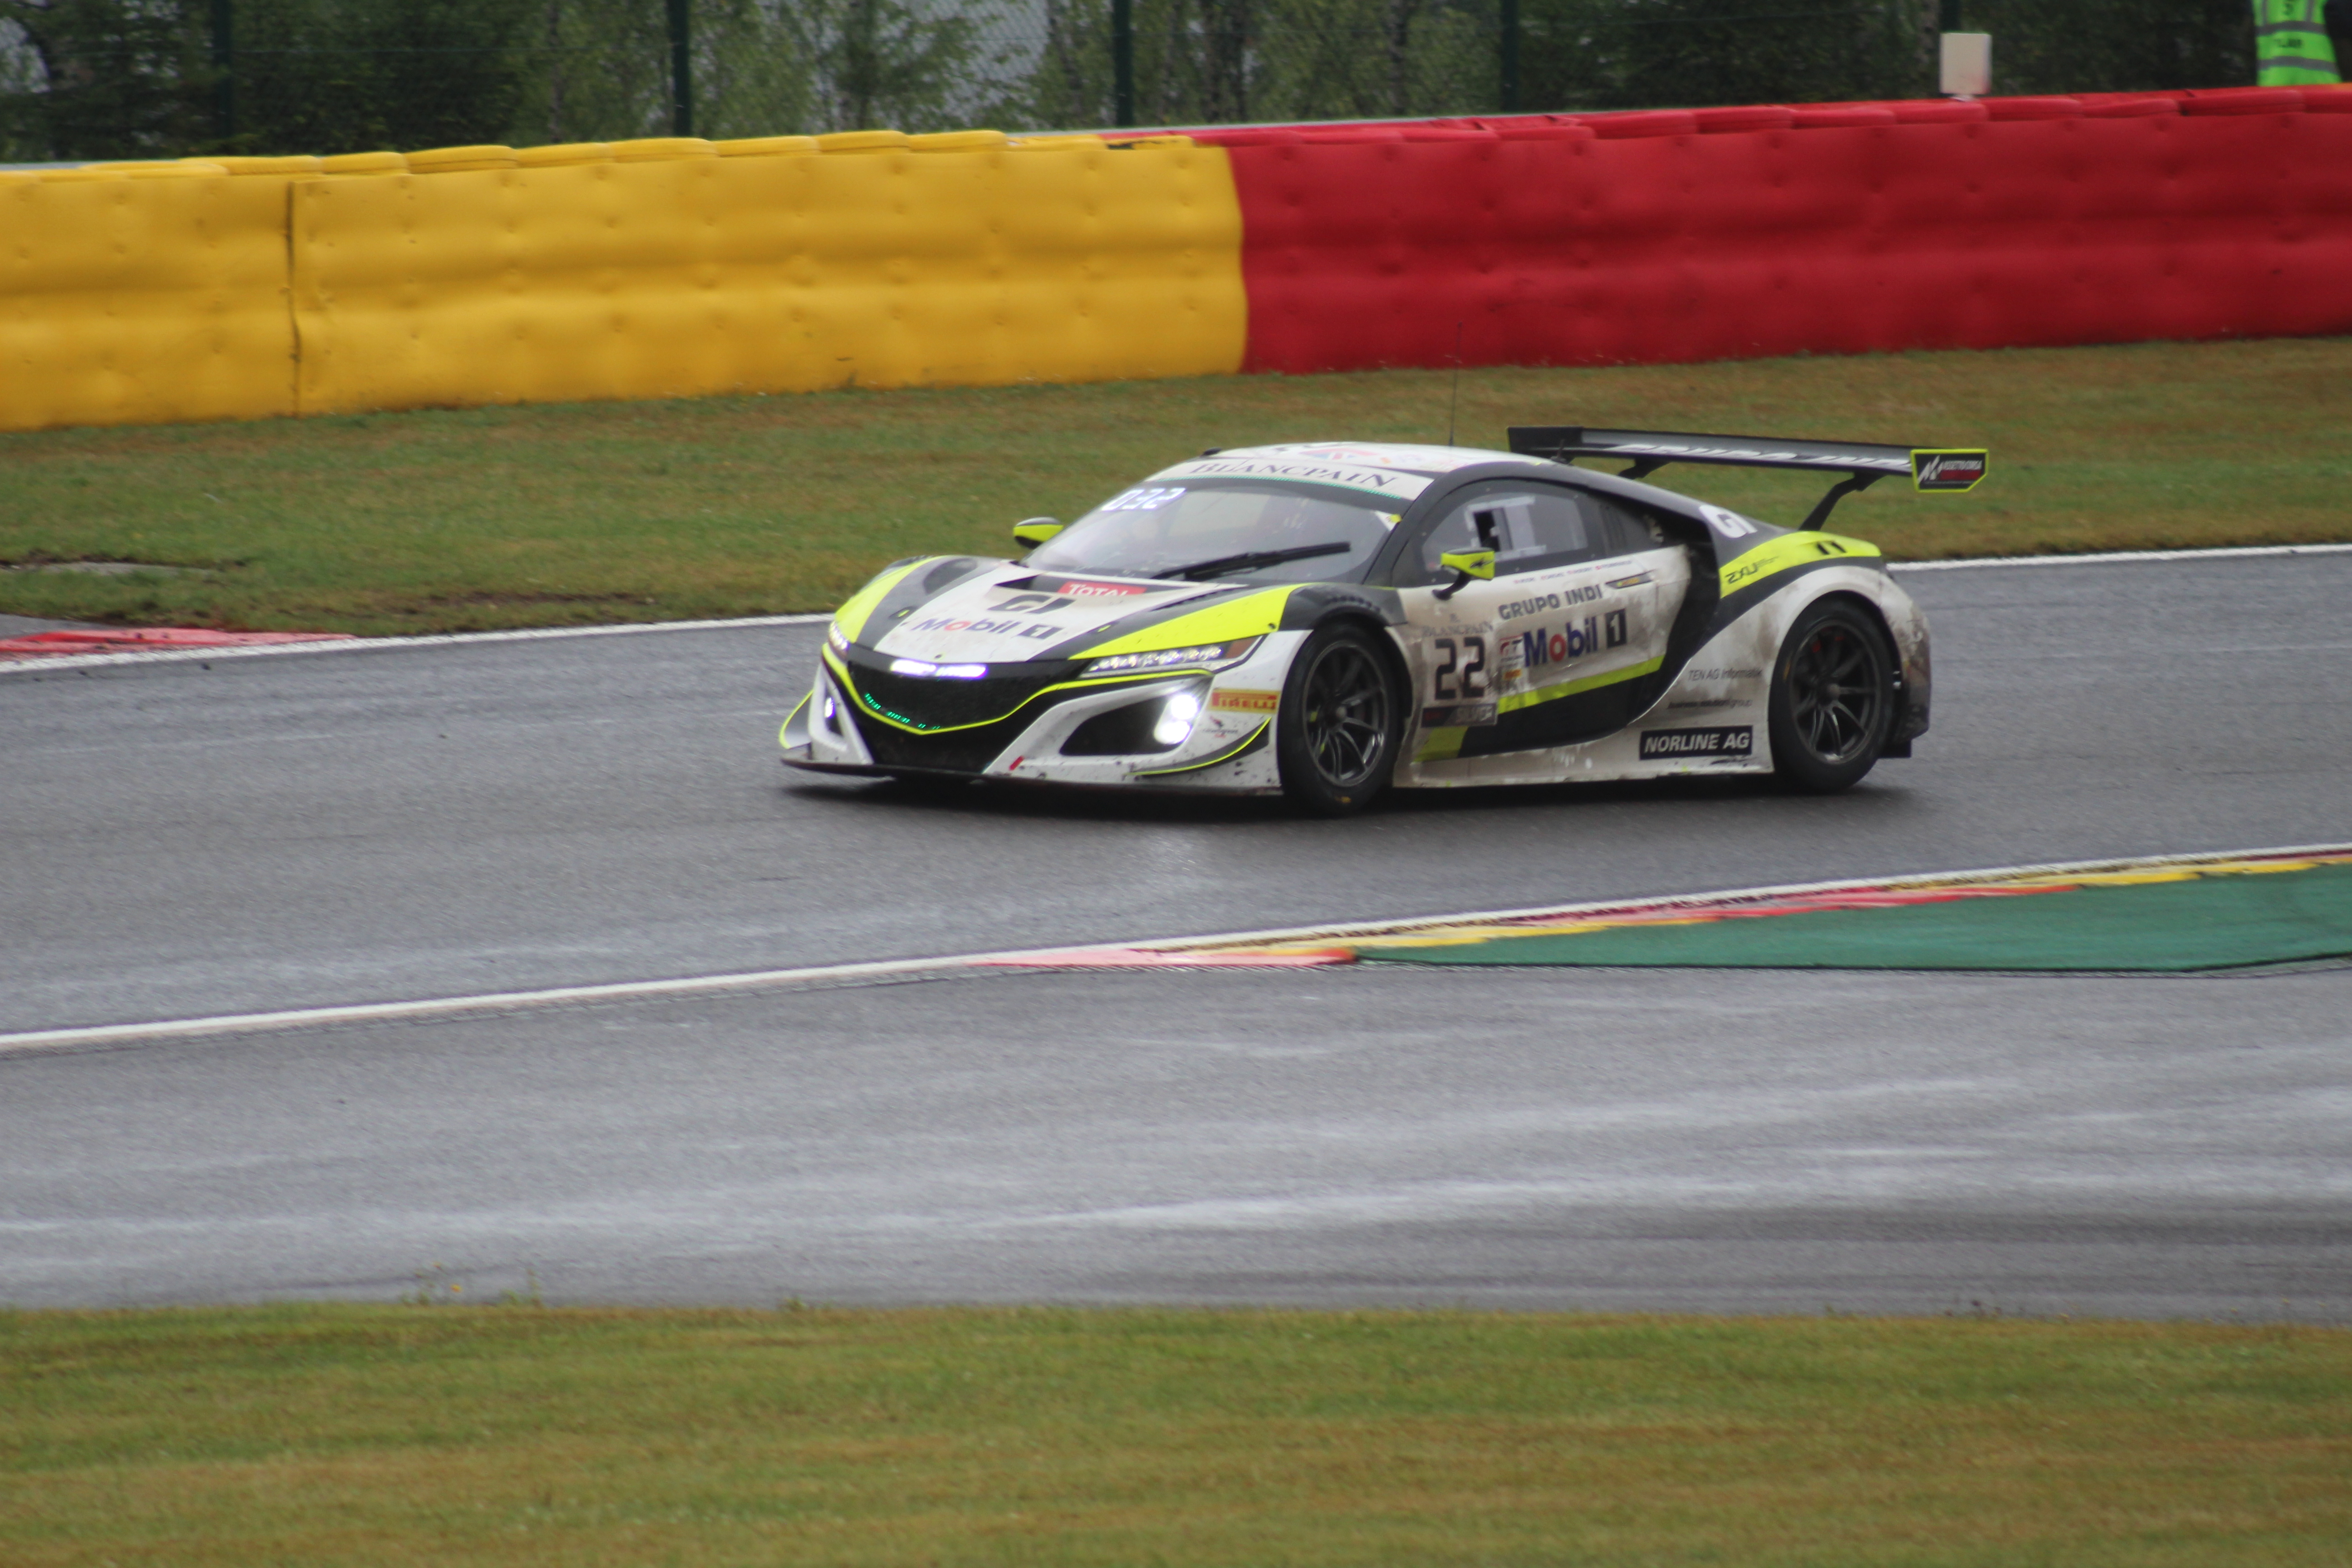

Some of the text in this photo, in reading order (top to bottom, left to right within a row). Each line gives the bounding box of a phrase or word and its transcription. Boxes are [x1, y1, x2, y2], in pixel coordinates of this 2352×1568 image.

[1190, 461, 1397, 487] BLANCPAIN
[1499, 583, 1603, 620] GRUPO INDI
[911, 618, 1024, 634] Mobil
[1523, 610, 1624, 667] Mobil 1
[1434, 636, 1485, 701] 22
[1688, 669, 1705, 681] TEN
[1706, 668, 1720, 680] AG
[1212, 692, 1276, 710] PIRELLI
[1644, 732, 1750, 754] NORLINE AG
